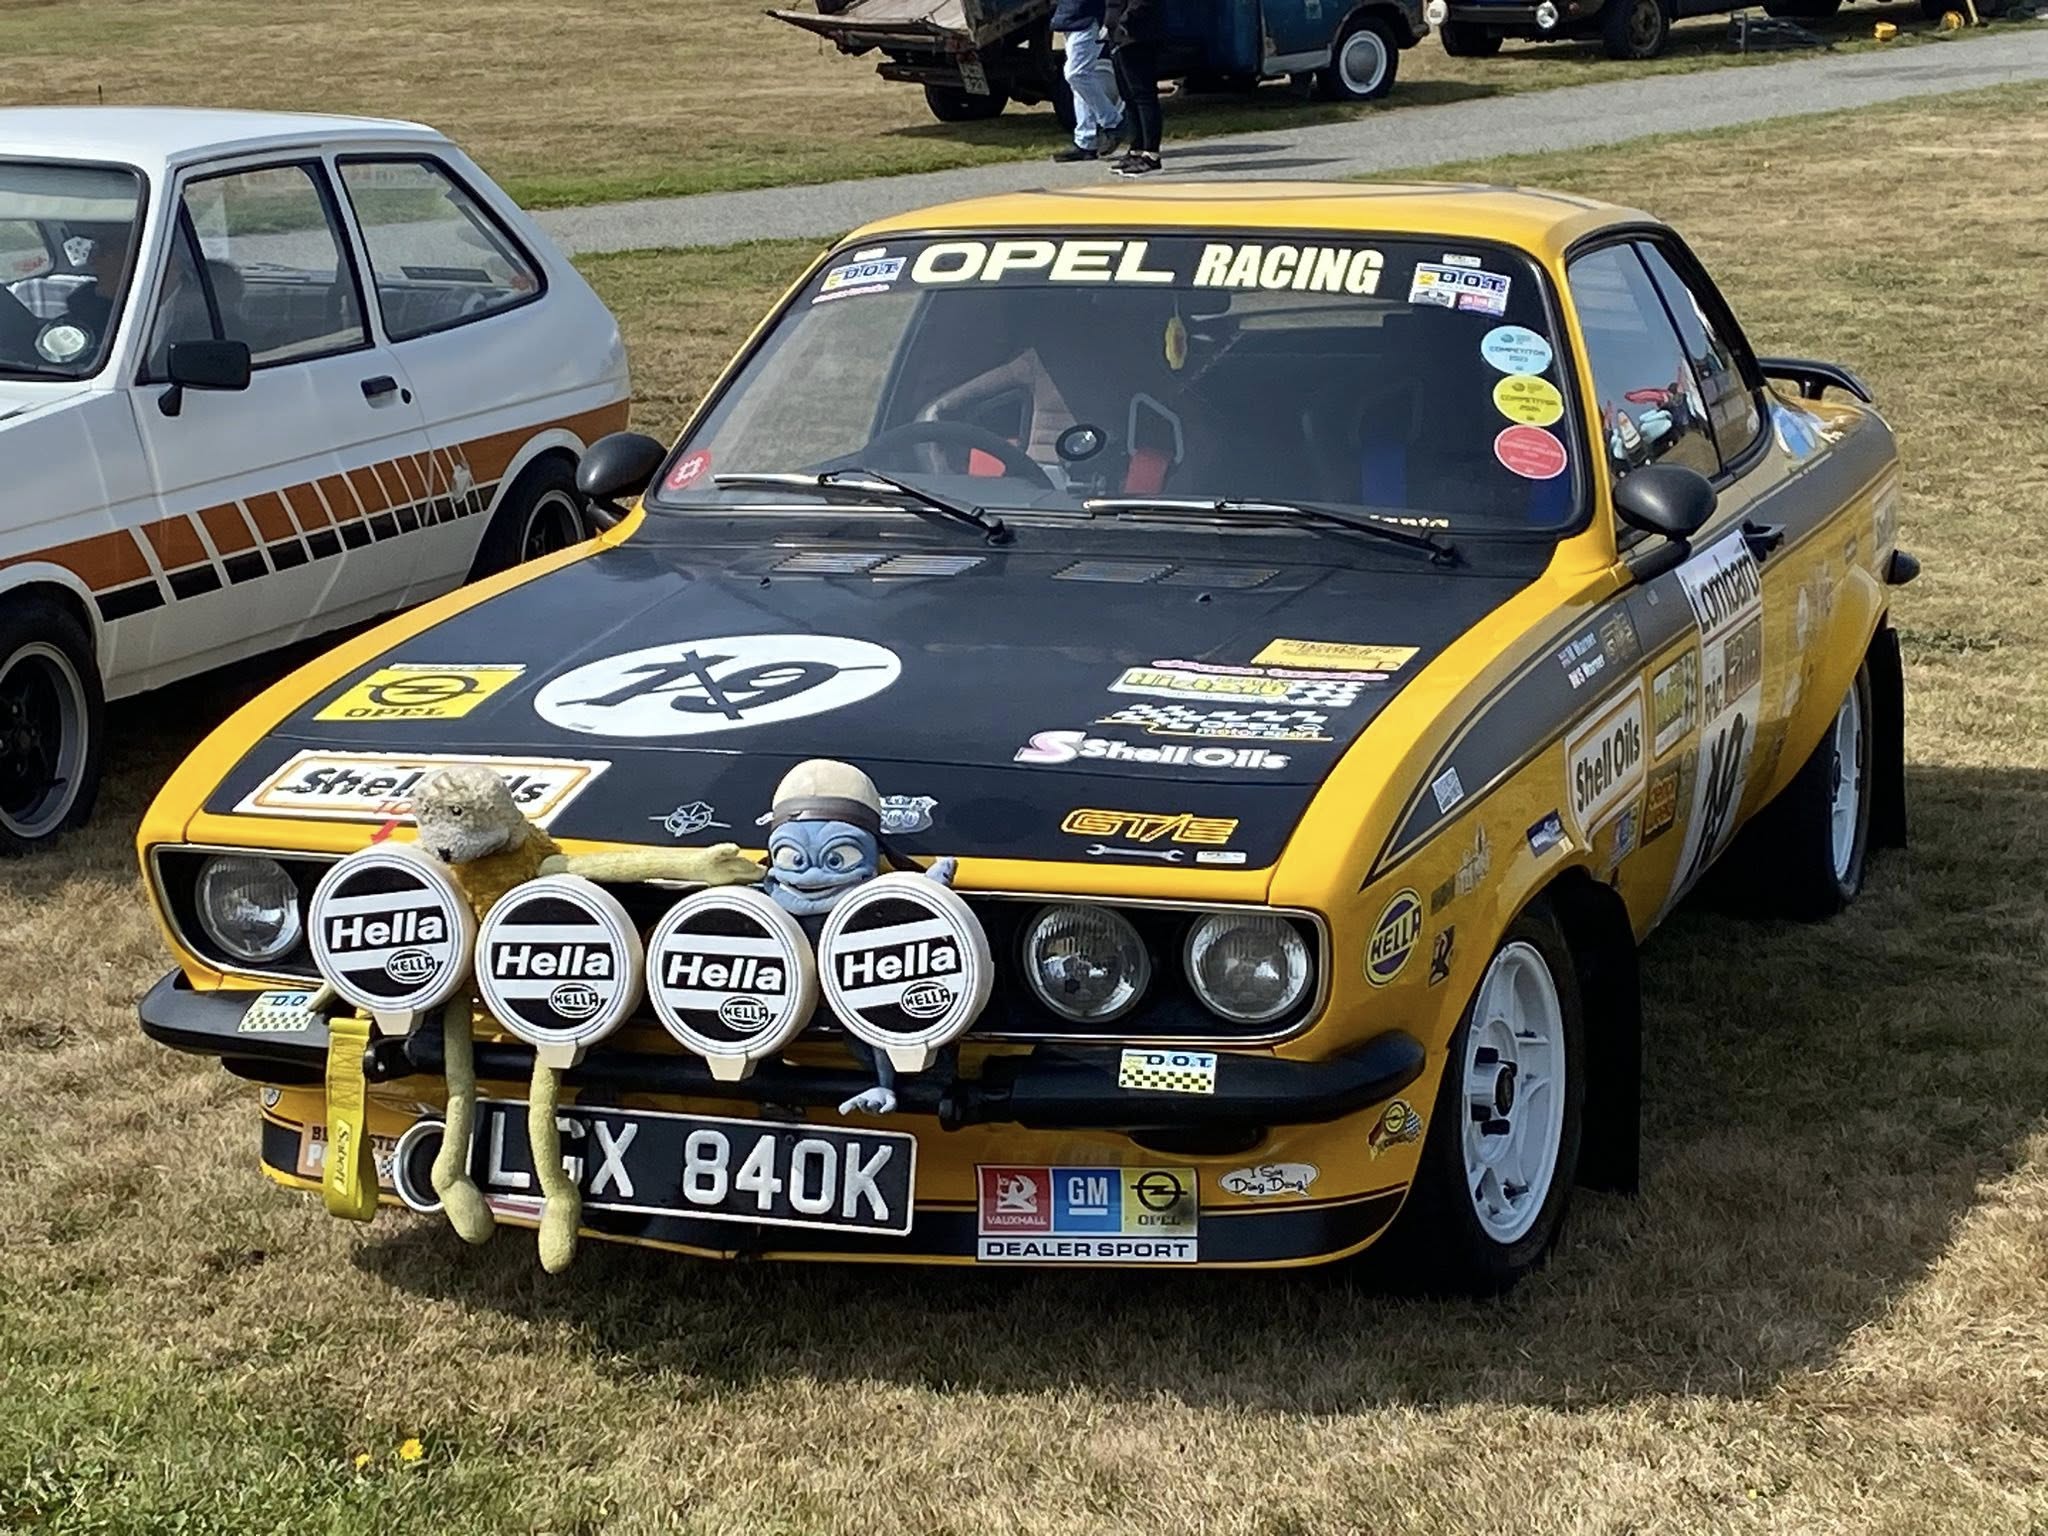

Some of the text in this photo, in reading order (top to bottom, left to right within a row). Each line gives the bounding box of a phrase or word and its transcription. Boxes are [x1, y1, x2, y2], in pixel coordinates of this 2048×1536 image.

[911, 241, 1385, 295] OPEL RACING
[1680, 536, 1760, 635] Lombard
[344, 706, 446, 718] OPEL
[1078, 738, 1193, 767] Shell
[1193, 746, 1292, 770] Oils
[1576, 736, 1613, 814] Shell
[1613, 717, 1641, 778] Oils
[276, 766, 427, 798] Shel
[331, 910, 444, 950] Hella
[1369, 904, 1421, 962] HELLA
[389, 952, 437, 974] HELLA
[495, 944, 614, 977] Hella
[666, 954, 784, 991] Hella
[842, 940, 957, 987] Hella
[552, 990, 600, 1009] HELLA
[723, 1002, 770, 1023] HELLA
[904, 987, 952, 1008] HELLA
[682, 1128, 893, 1222] 840K
[1067, 1176, 1109, 1206] GM
[986, 1214, 1048, 1226] VAUXHALL
[1136, 1214, 1181, 1227] OPEL
[986, 1242, 1190, 1258] DEALER SPORT
